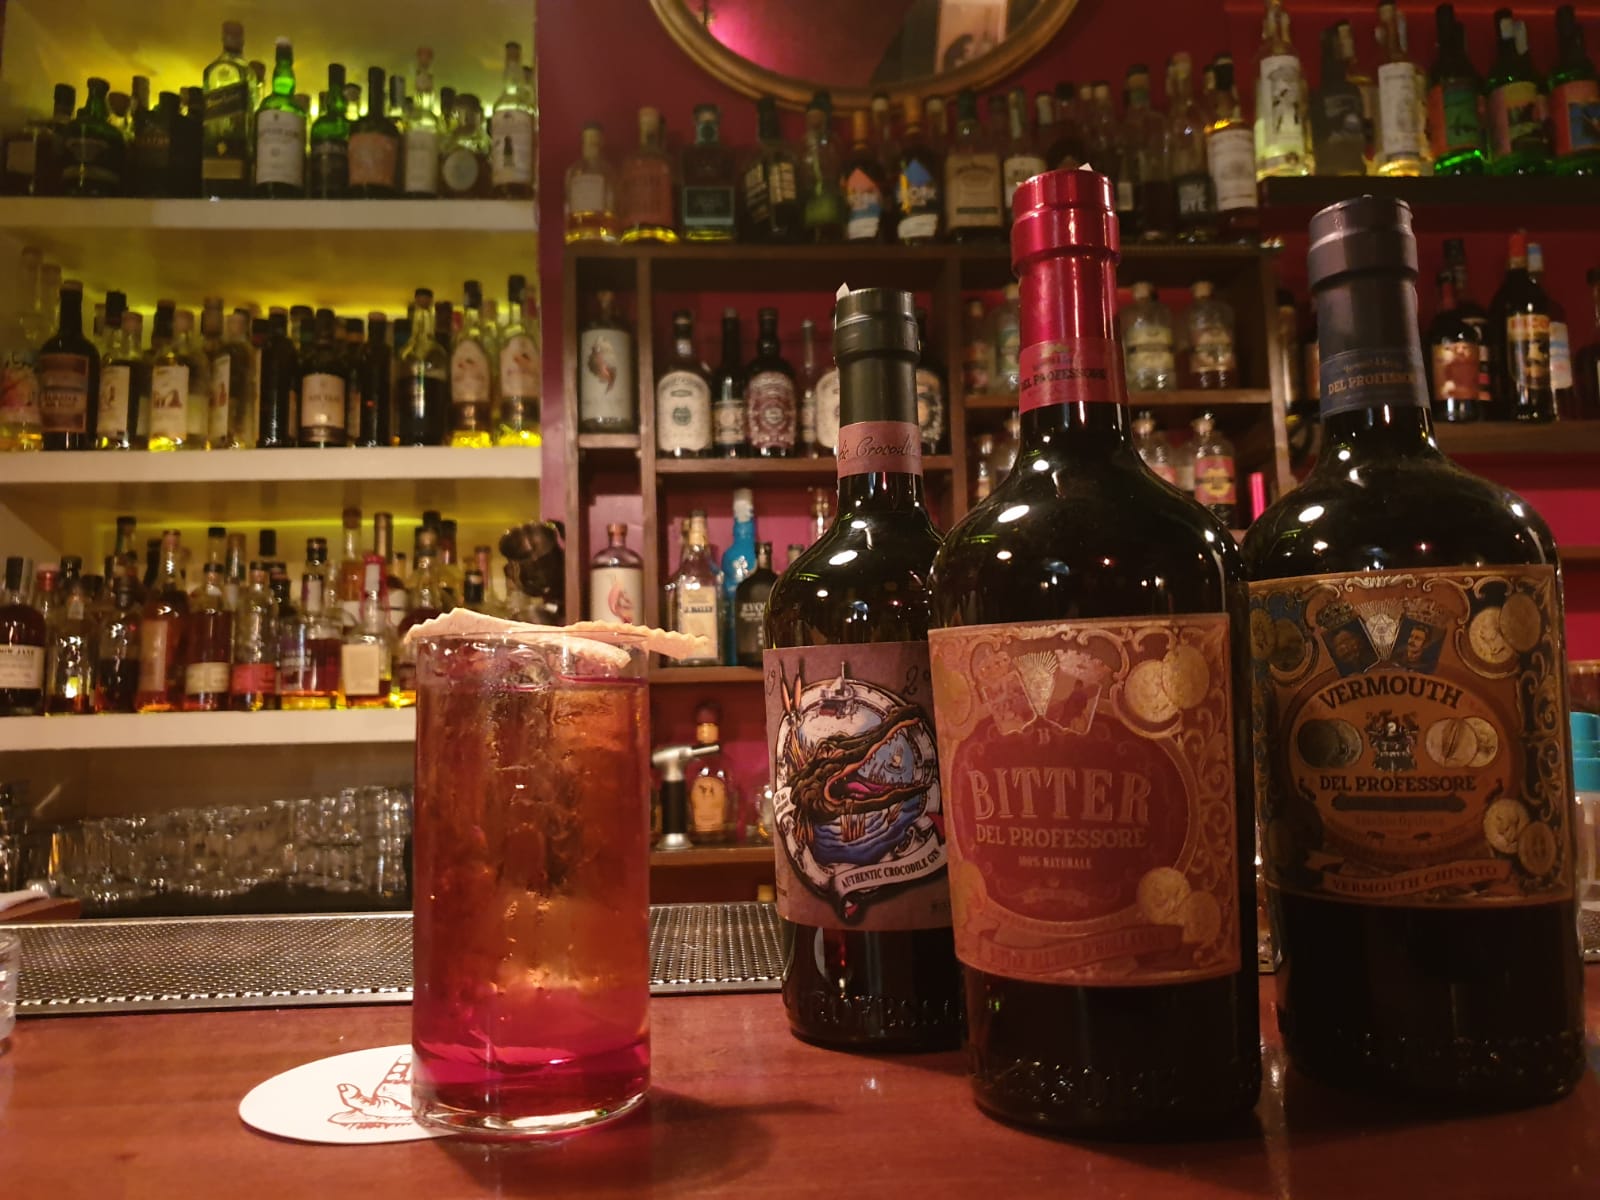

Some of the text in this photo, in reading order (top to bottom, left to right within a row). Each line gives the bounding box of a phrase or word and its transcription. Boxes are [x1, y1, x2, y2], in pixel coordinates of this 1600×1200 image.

[1328, 378, 1347, 395] DEL
[1319, 675, 1464, 710] VERMOUTH
[968, 767, 1152, 824] BITTER
[1320, 775, 1478, 793] DEL PROFESSORE
[975, 822, 1149, 850] DEL PROFESSORE
[841, 868, 883, 889] AUTHENTIC
[883, 855, 929, 878] CROCODILE
